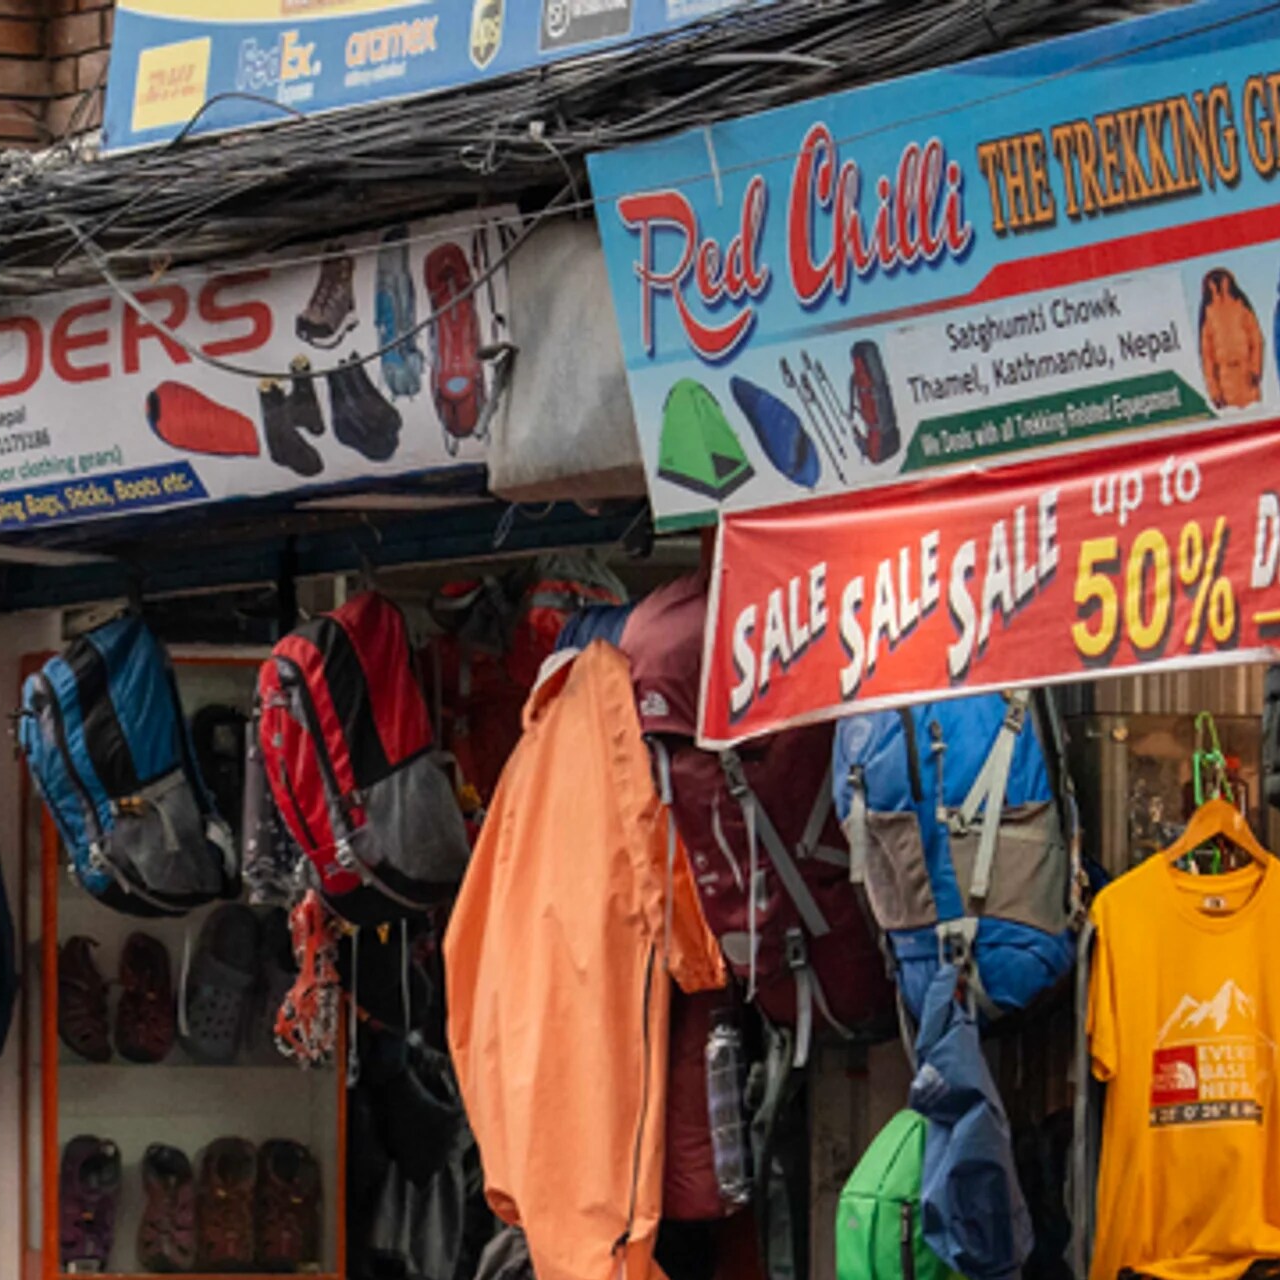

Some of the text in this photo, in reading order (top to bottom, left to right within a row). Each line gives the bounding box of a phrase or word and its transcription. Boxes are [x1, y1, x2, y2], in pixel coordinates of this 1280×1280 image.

[345, 16, 439, 68] aramex
[618, 176, 767, 358] Red
[786, 122, 972, 305] Chilli
[978, 131, 1050, 236] THE
[1051, 84, 1242, 220] TREKKING
[1050, 288, 1122, 329] Chowk
[907, 321, 1183, 404] Thamel, Kathmandu, Nepal
[1016, 408, 1067, 439] Trekking
[1091, 457, 1201, 524] up to
[729, 560, 829, 716] SALE
[838, 528, 941, 697] SALE
[947, 489, 1061, 682] SALE
[1069, 515, 1238, 662] 50%
